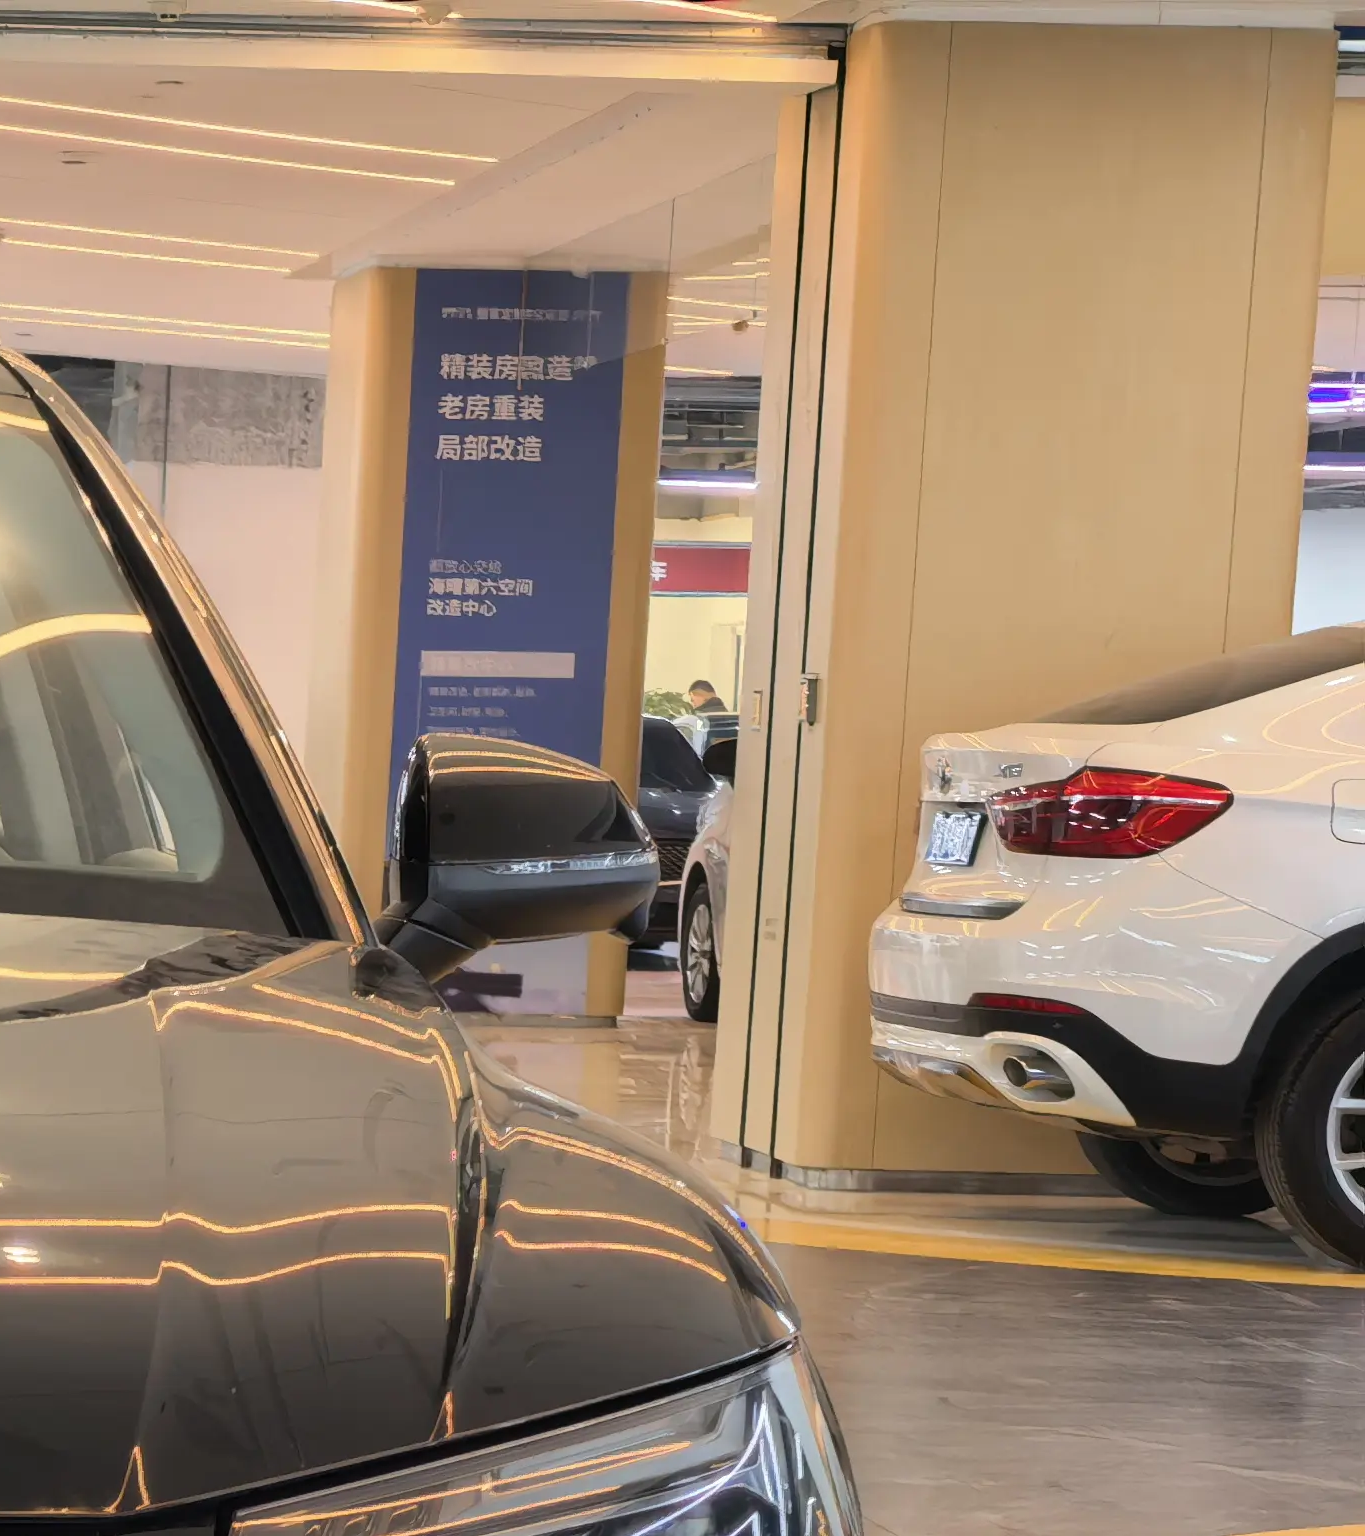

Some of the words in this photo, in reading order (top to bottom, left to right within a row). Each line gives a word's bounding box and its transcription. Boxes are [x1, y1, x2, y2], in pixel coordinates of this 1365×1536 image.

[438, 393, 544, 421] 老房重装
[435, 434, 543, 462] 局部改造
